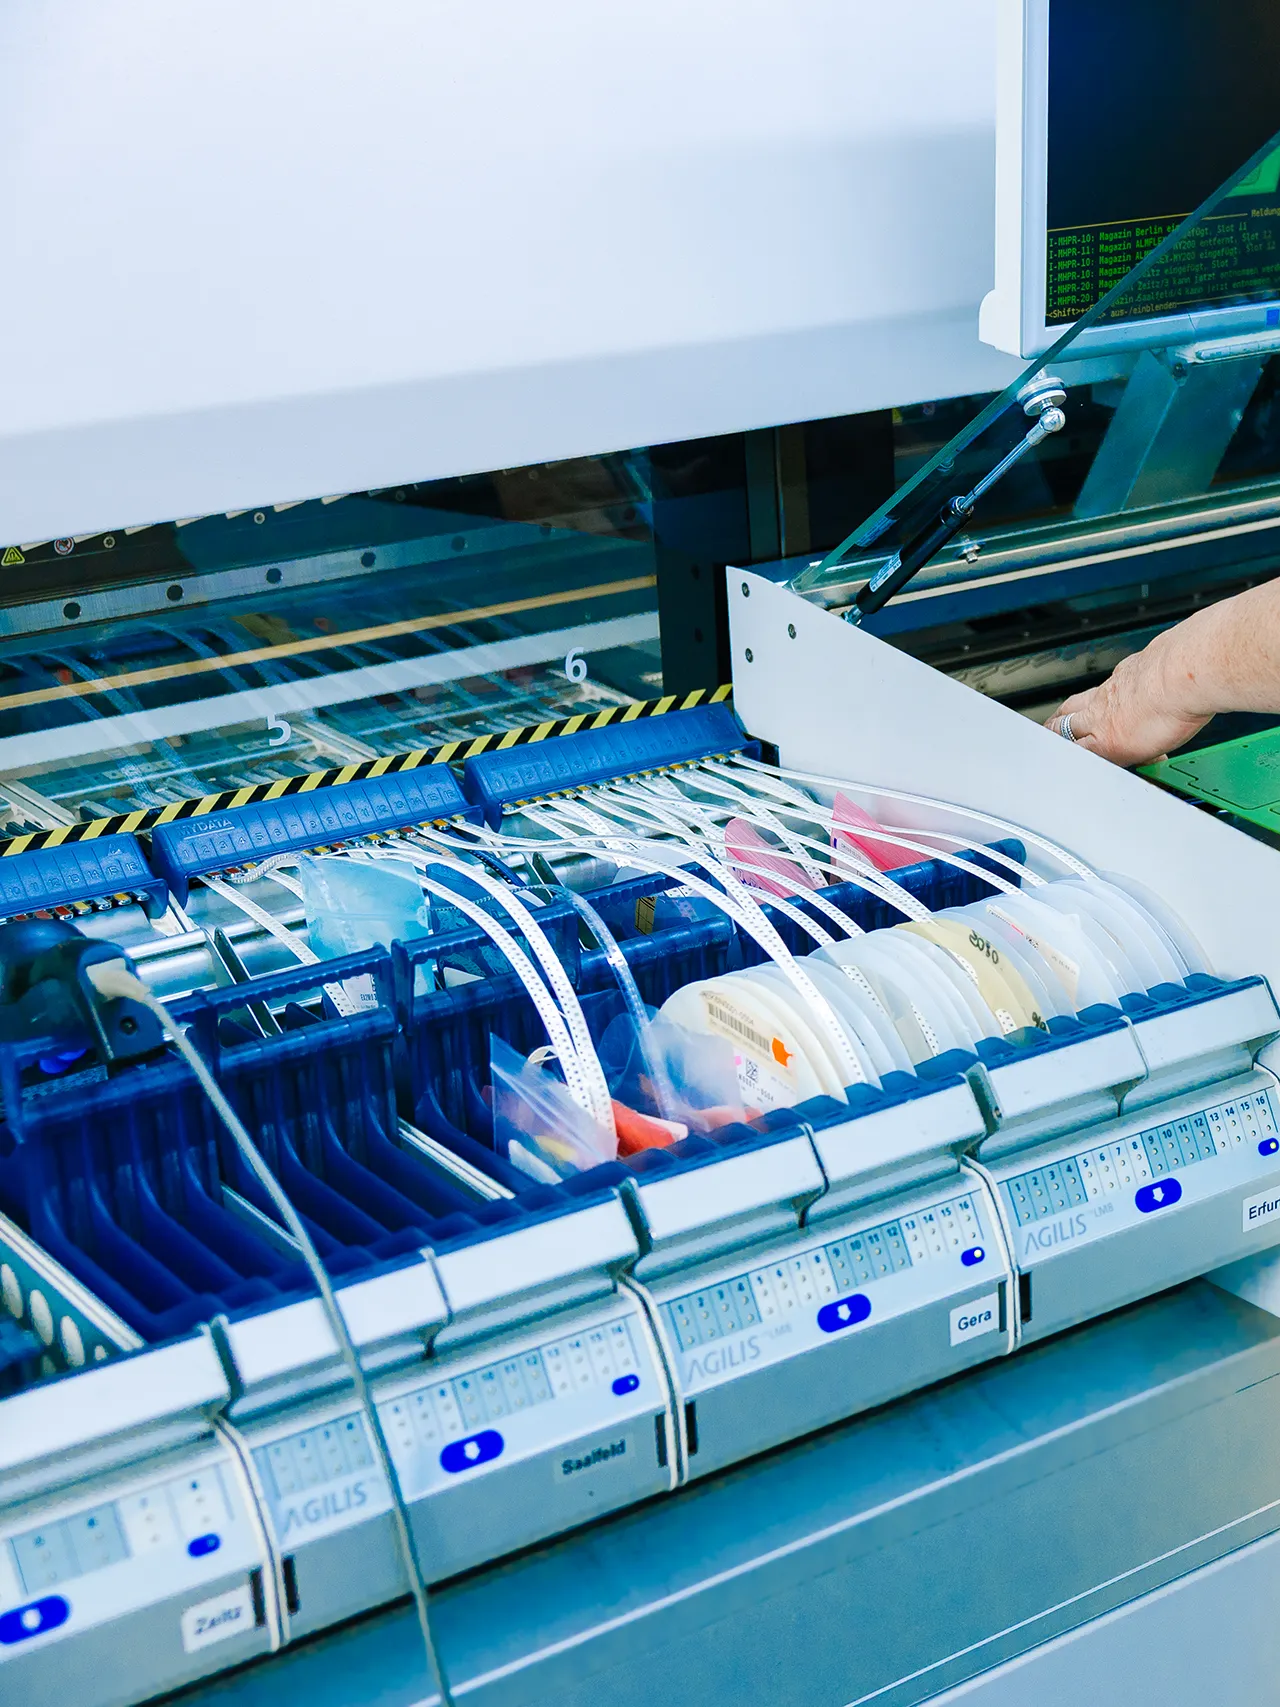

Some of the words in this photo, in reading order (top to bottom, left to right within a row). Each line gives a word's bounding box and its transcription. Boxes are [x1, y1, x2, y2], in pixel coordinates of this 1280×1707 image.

[1049, 234, 1094, 247] I-MHPR-10:
[1100, 230, 1132, 241] Magazin
[1136, 225, 1163, 237] Berlin
[1217, 224, 1234, 233] Slot
[1049, 246, 1094, 259] I-MHPR-11:
[1099, 242, 1131, 253] Magazin
[1242, 232, 1259, 241] Slot
[1099, 254, 1131, 265] Magazin
[1246, 243, 1262, 253] Slot
[1099, 266, 1131, 277] Magazin
[1212, 260, 1228, 269] Slot
[565, 647, 587, 683] 6
[267, 714, 292, 746] 5
[201, 845, 210, 853] 2
[68, 874, 80, 883] 13
[87, 870, 99, 880] 14
[107, 866, 118, 875] 15
[126, 862, 137, 871] 16
[1015, 1183, 1020, 1191] 1
[1032, 1177, 1038, 1186] 2
[1049, 1171, 1055, 1180] 3
[1066, 1164, 1072, 1172] 4
[1083, 1159, 1088, 1167] 5
[1100, 1153, 1105, 1161] 6
[1116, 1147, 1121, 1156] 7
[1132, 1141, 1138, 1150] 8
[1148, 1135, 1154, 1144] 9
[1162, 1129, 1172, 1139] 10
[1178, 1123, 1188, 1133] 11
[1194, 1118, 1204, 1127] 12
[1210, 1112, 1220, 1122] 13
[1225, 1107, 1235, 1117] 14
[1240, 1102, 1250, 1111] 15
[1255, 1096, 1265, 1105] 16
[833, 1247, 840, 1257] 9
[850, 1240, 862, 1250] 10
[868, 1233, 880, 1244] 11
[886, 1227, 898, 1237] 12
[905, 1220, 916, 1230] 13
[923, 1213, 934, 1224] 14
[941, 1207, 951, 1217] 15
[959, 1201, 970, 1211] 16
[1025, 1214, 1087, 1255] AGILIS
[958, 1310, 992, 1331] Gera
[688, 1334, 761, 1382] AGILIS
[562, 1438, 626, 1475] Saalfeld
[279, 1481, 368, 1542] AGILIS
